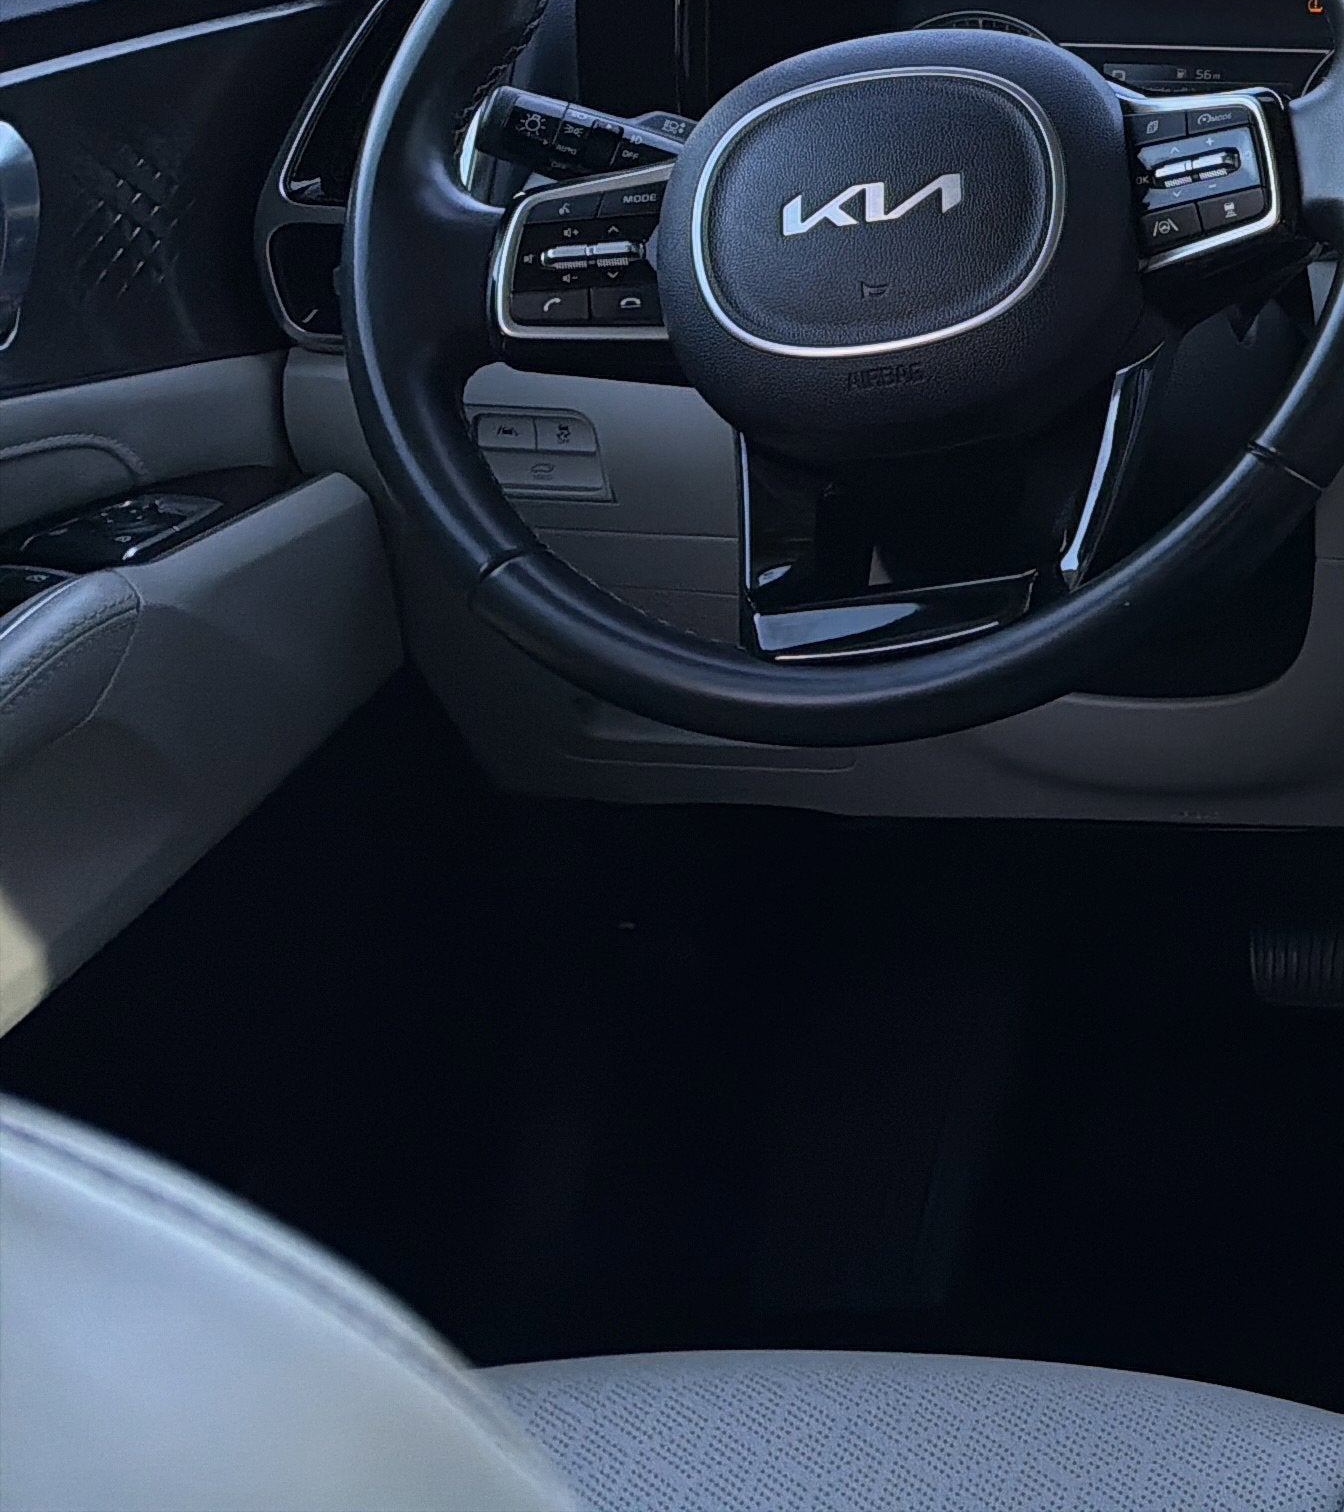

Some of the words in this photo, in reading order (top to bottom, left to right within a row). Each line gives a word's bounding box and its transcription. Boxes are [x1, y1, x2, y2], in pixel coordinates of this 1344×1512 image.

[621, 148, 640, 160] OFF
[622, 192, 657, 204] MODE
[782, 172, 964, 237] KIA
